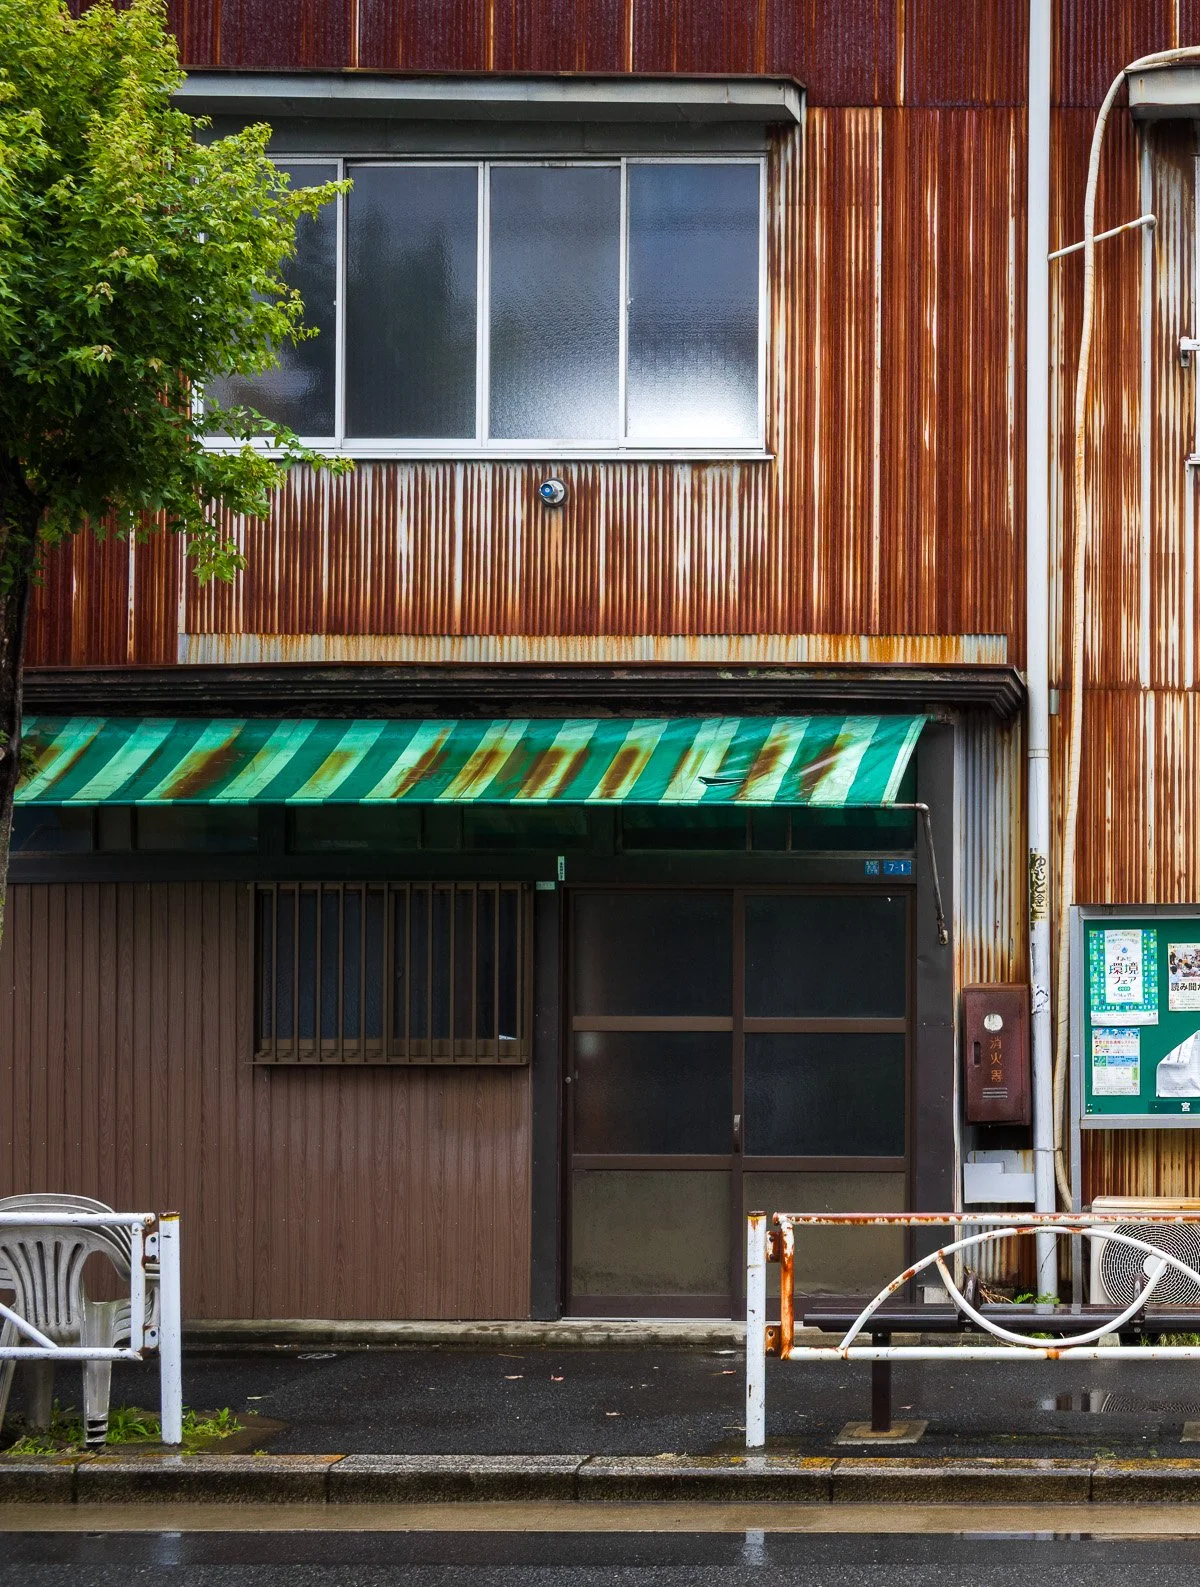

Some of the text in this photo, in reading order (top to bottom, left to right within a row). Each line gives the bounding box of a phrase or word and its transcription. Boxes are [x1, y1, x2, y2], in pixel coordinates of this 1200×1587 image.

[888, 863, 905, 872] 7-1
[1108, 962, 1140, 976] 環境
[1112, 976, 1137, 985] フェア
[990, 1036, 1004, 1083] 消火器
